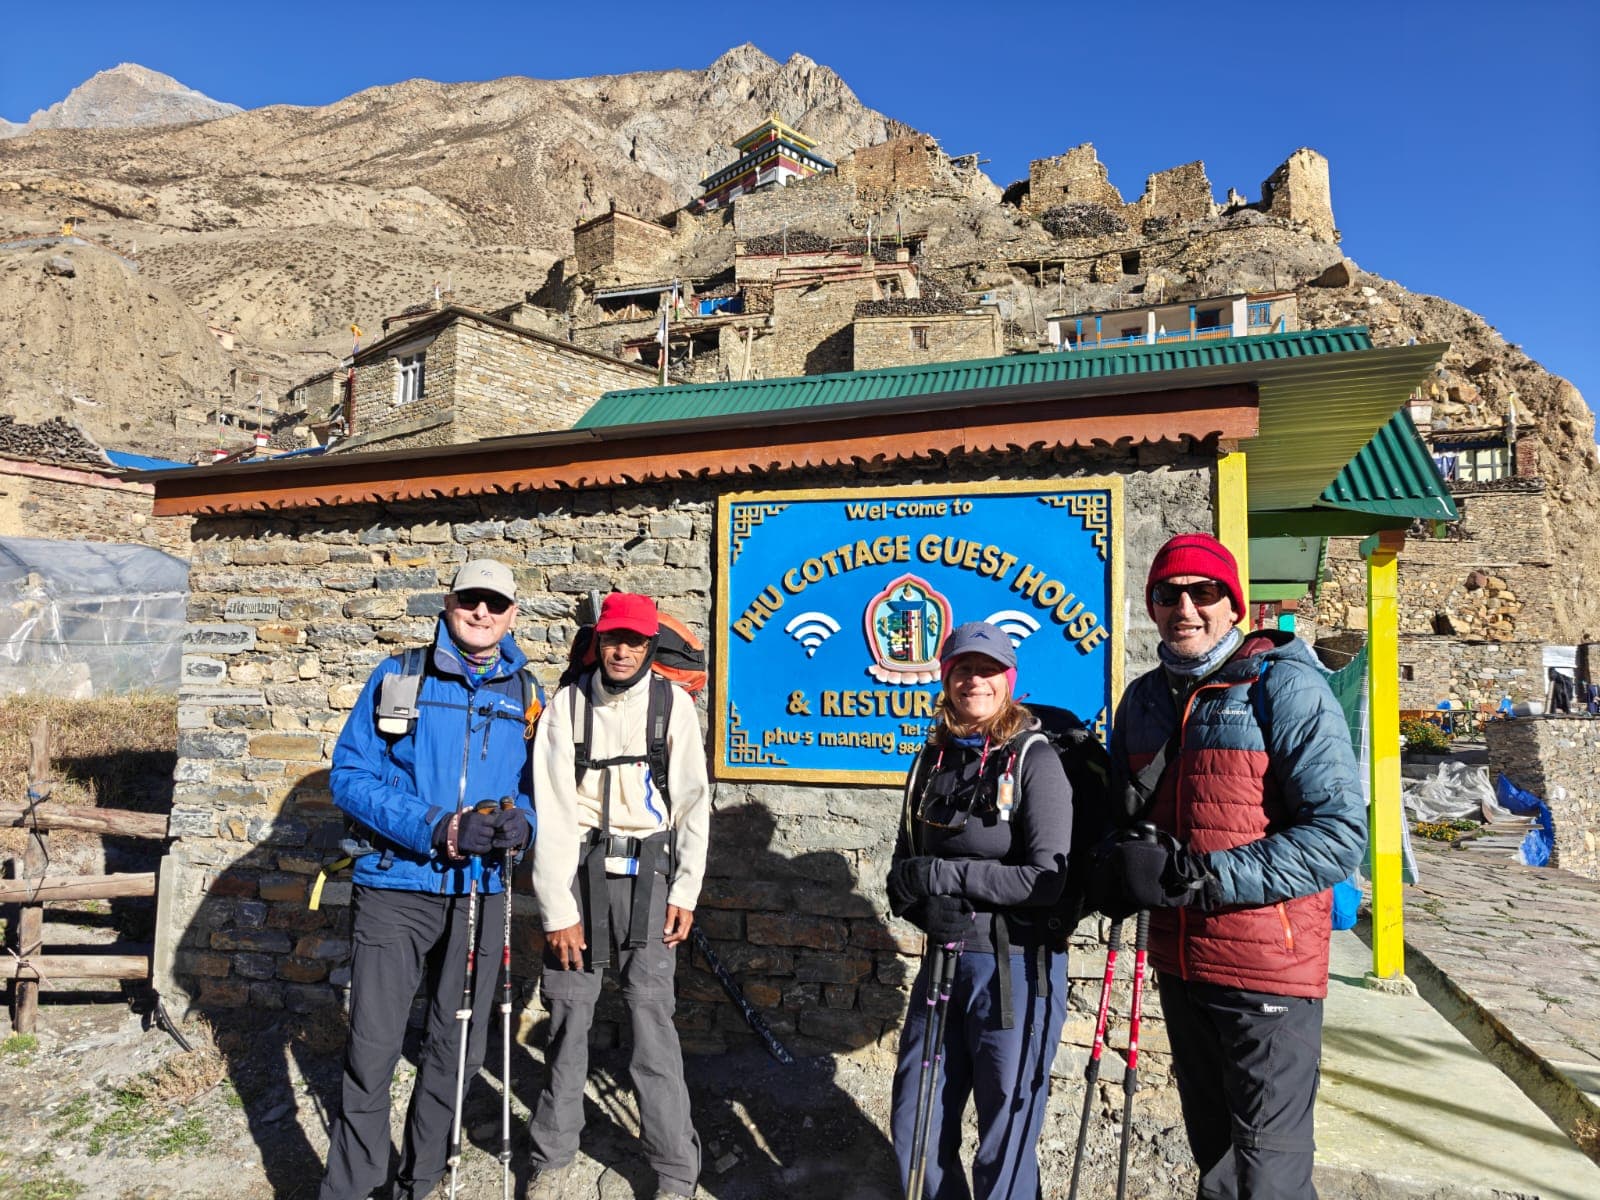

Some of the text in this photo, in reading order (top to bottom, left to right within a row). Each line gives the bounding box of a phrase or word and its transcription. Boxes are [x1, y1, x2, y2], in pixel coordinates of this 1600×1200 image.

[847, 499, 973, 519] Wel-come to
[732, 534, 1110, 654] PHU COTTAGE GUEST HOUSE
[789, 690, 812, 715] &
[820, 731, 895, 753] manang
